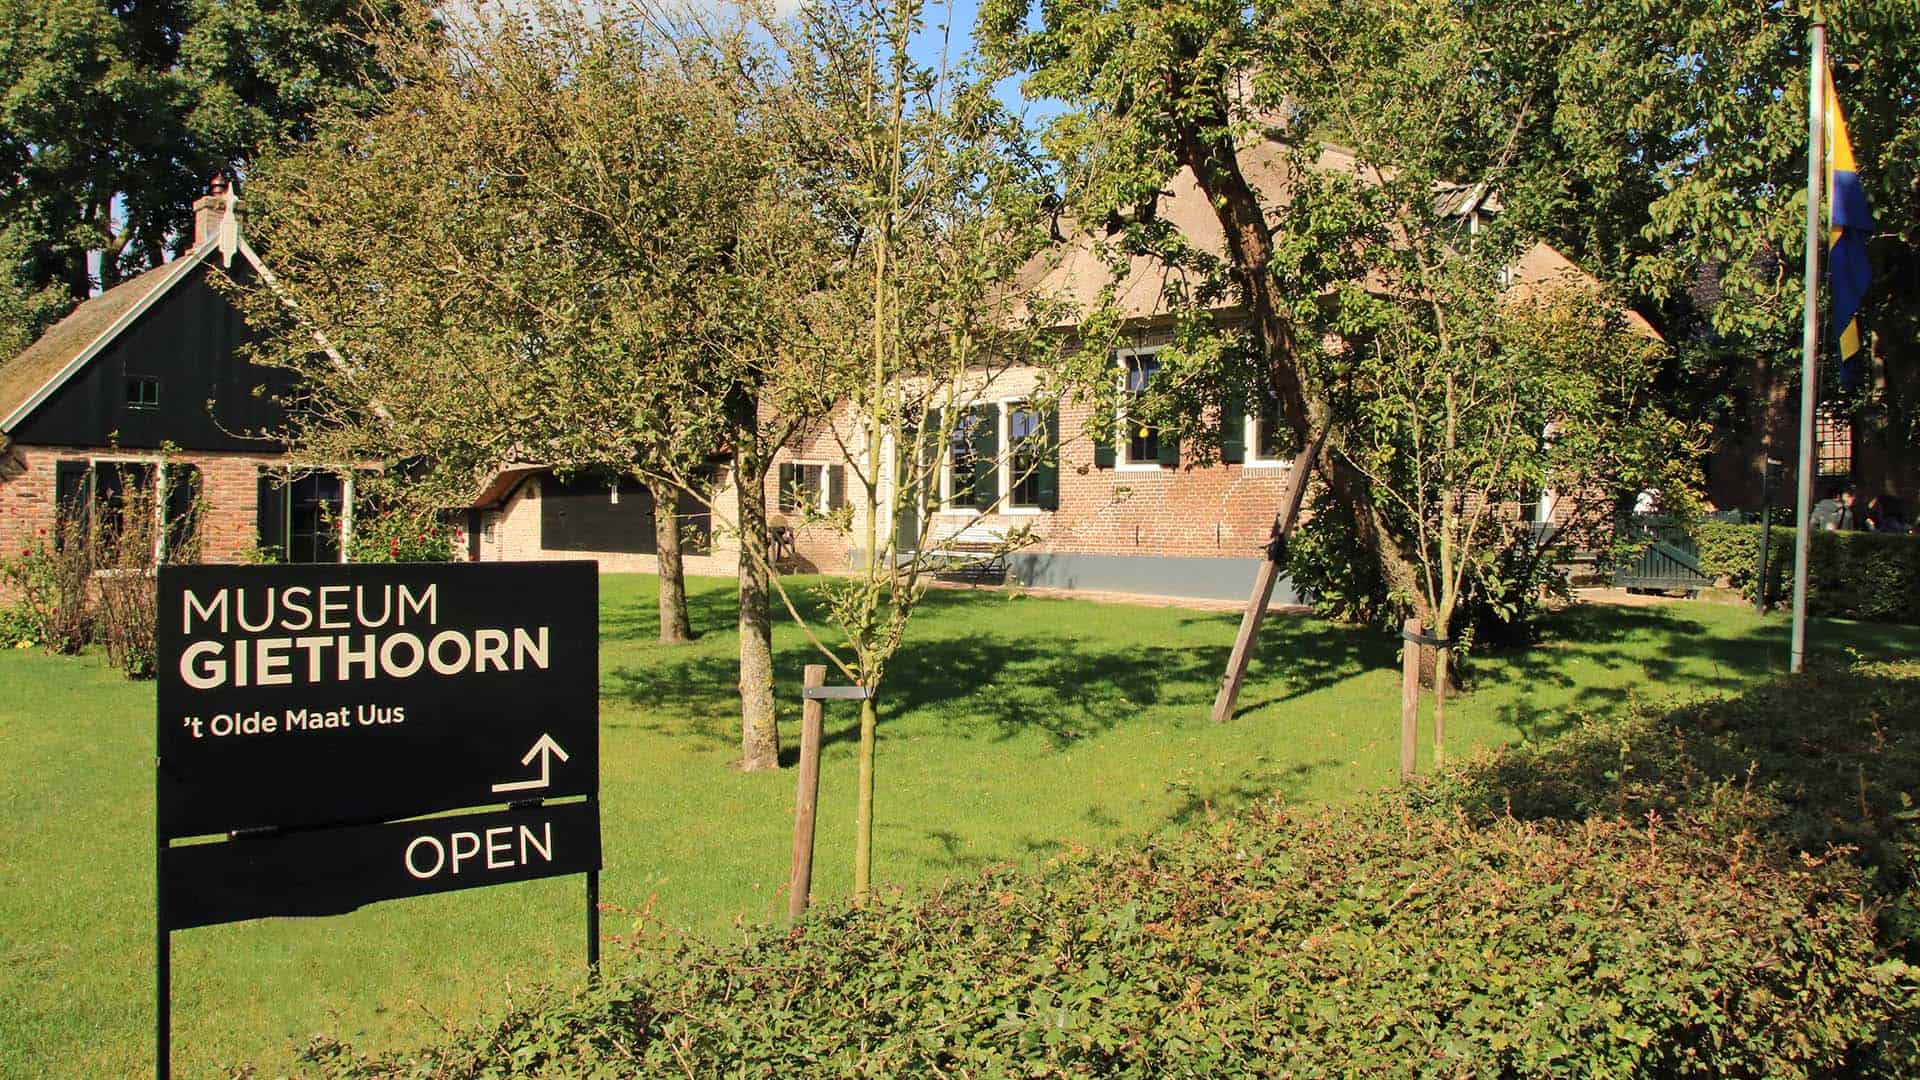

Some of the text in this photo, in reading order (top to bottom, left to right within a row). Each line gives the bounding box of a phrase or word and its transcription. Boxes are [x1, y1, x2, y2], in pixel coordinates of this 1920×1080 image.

[182, 583, 437, 635] MUSEUM
[180, 626, 549, 689] GIETHOORN
[210, 711, 278, 737] Olde
[285, 703, 351, 731] Maat
[357, 703, 405, 726] Uus
[404, 822, 553, 879] OPEN
